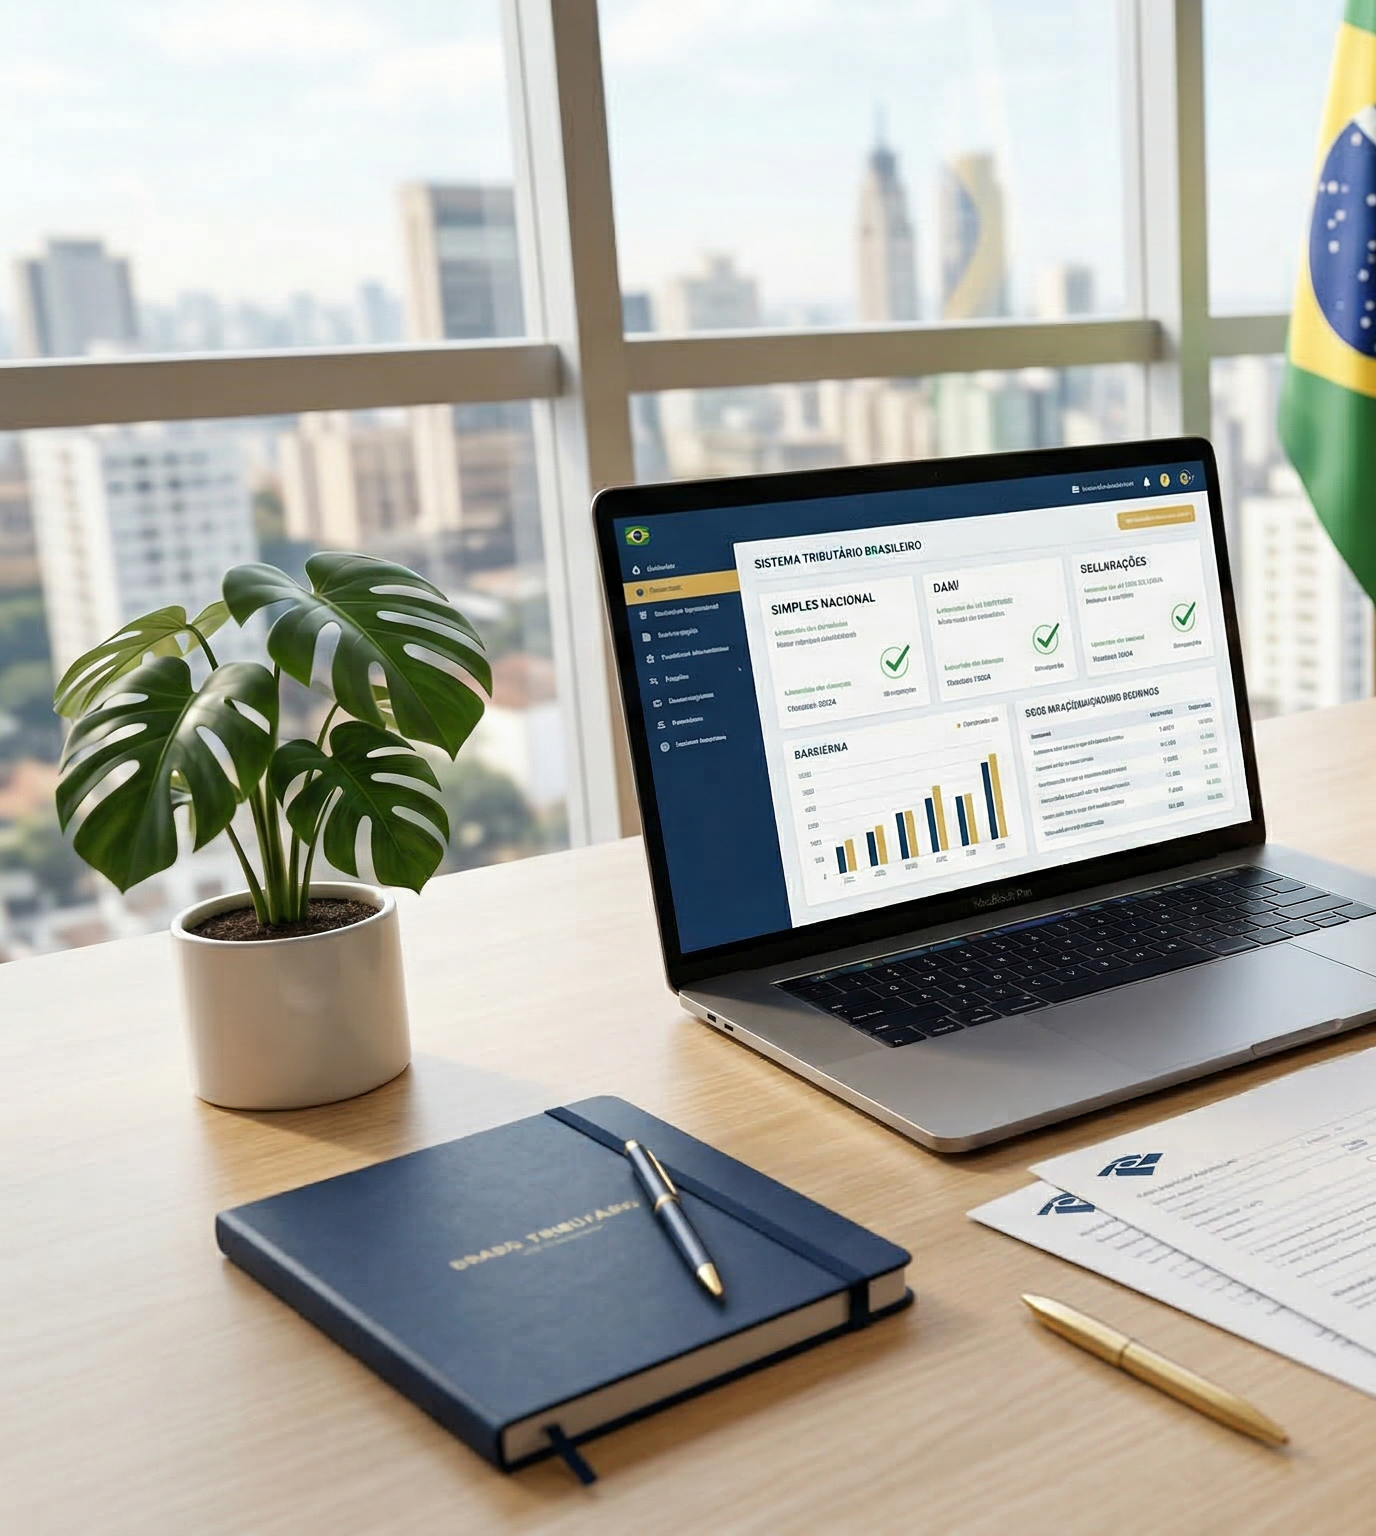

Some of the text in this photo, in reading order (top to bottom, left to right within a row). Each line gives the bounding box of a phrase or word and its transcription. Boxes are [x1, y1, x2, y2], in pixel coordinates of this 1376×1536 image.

[754, 540, 922, 569] SISTEMA TRIBUTÁRIO BRASILEIRO
[771, 592, 876, 616] SIMPLES NACIONAL
